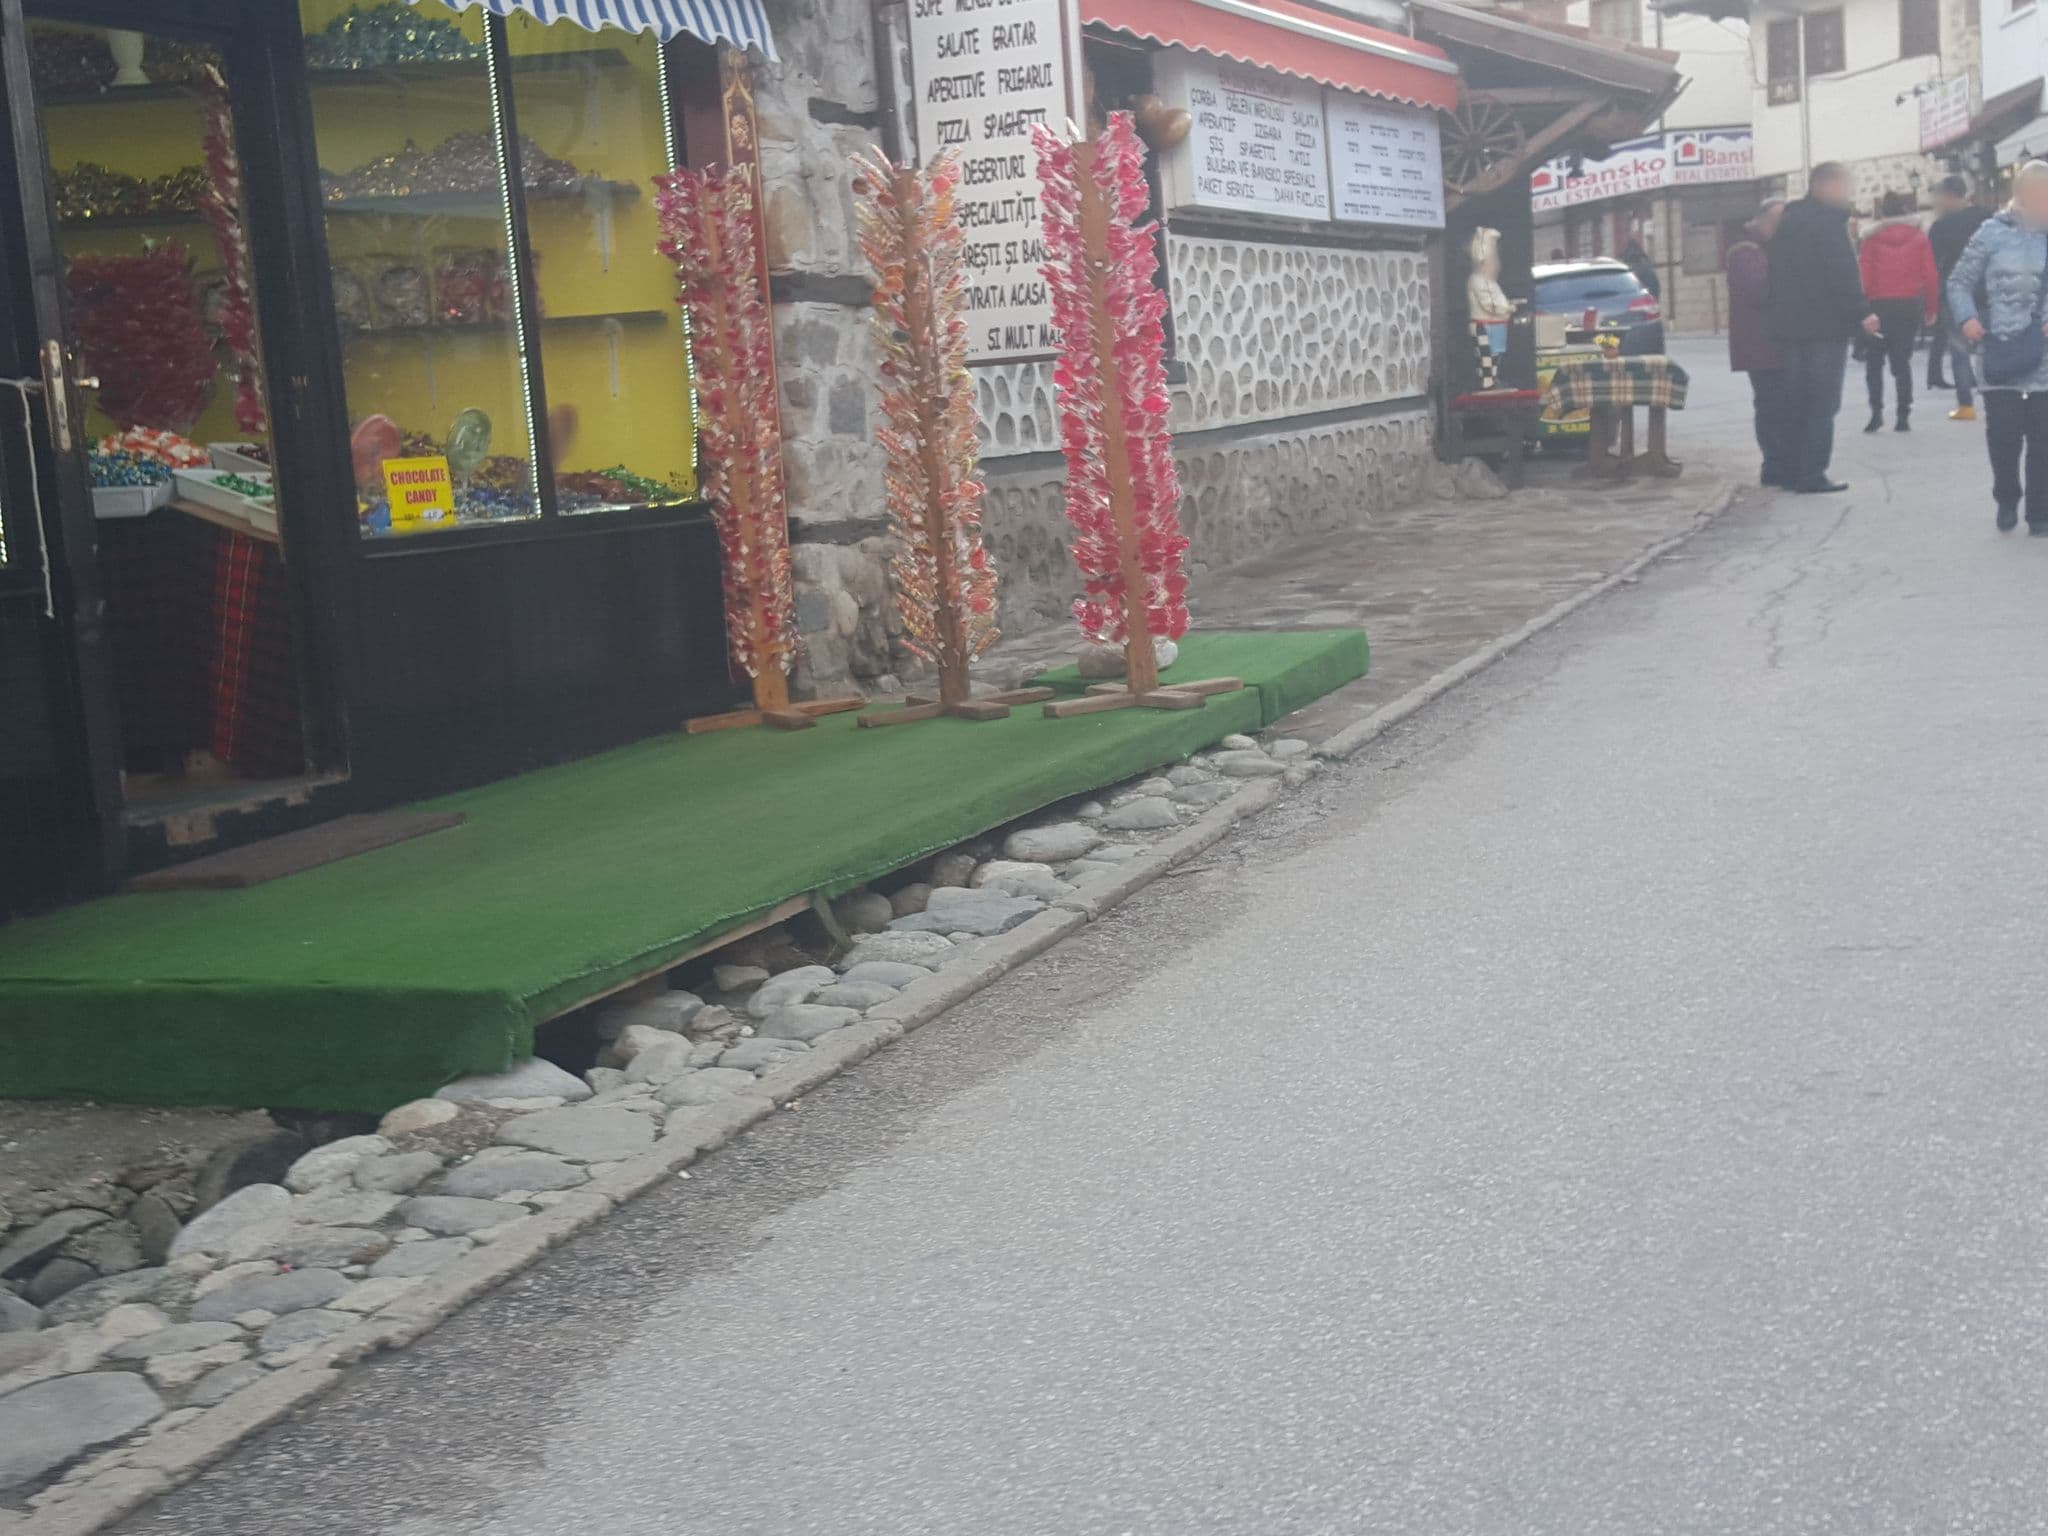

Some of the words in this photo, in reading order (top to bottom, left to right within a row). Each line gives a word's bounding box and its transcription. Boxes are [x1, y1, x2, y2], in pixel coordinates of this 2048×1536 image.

[937, 28, 980, 59] SALATE
[992, 20, 1037, 51] GRATAR
[927, 71, 986, 103] APERITIVE
[998, 62, 1053, 94] FRIGARUI
[937, 118, 971, 145] PIZZA
[963, 155, 1026, 186] DESERTURI
[1010, 282, 1048, 307] ACASA
[1005, 324, 1034, 350] MULT
[390, 468, 445, 486] CHOCOLATE
[405, 489, 437, 504] CANDY
